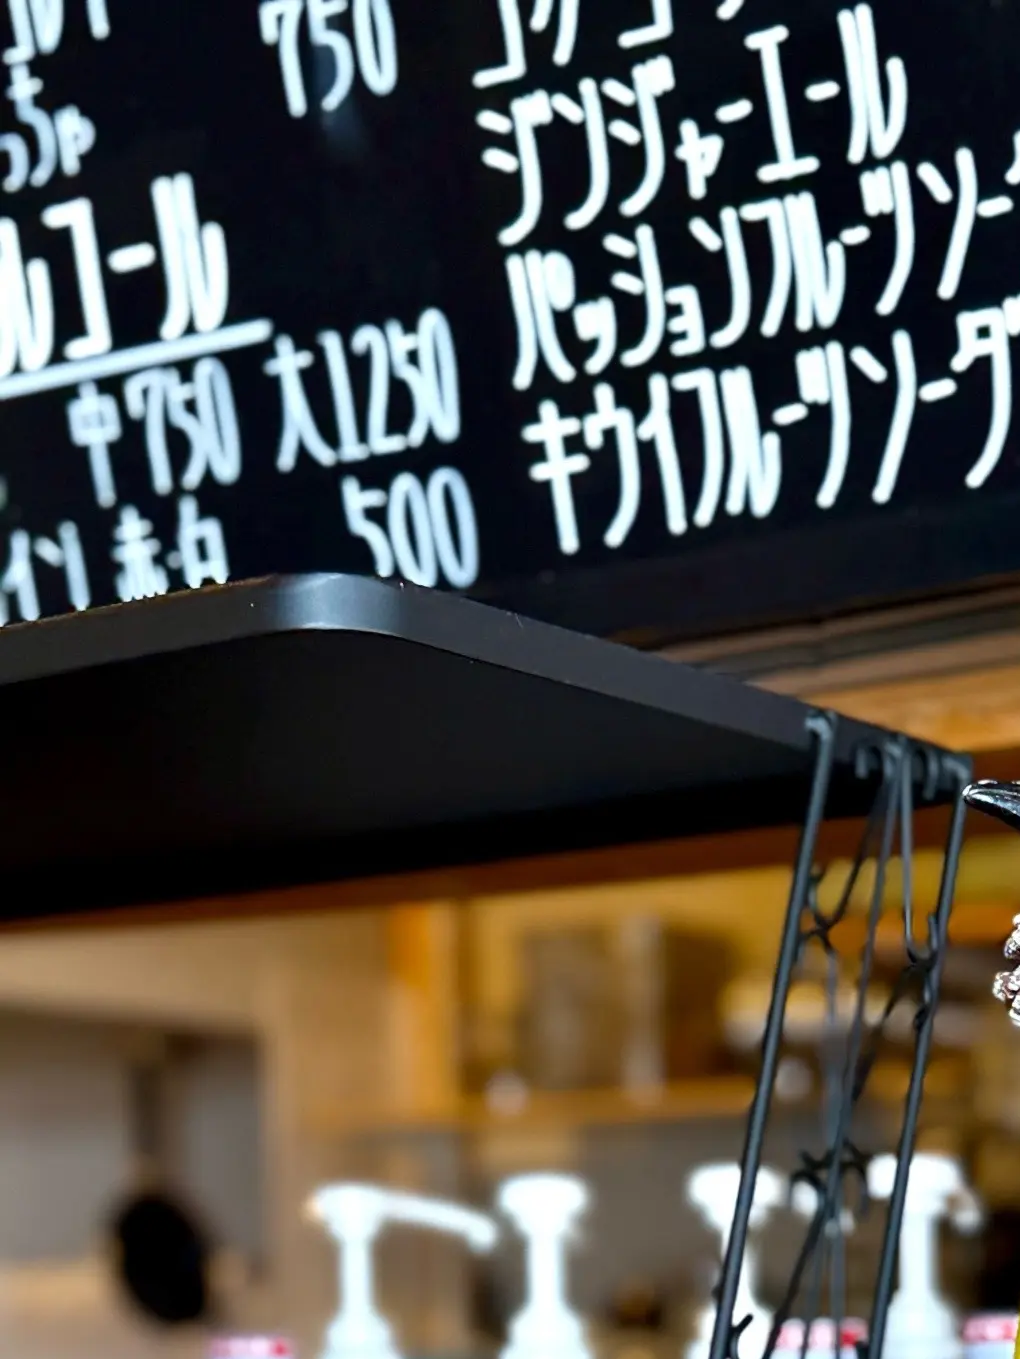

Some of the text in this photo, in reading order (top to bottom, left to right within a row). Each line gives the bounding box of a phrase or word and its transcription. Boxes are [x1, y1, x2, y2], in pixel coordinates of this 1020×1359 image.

[261, 0, 397, 117] 750
[475, 3, 908, 246] ジンジャーエール
[341, 466, 479, 588] 500
